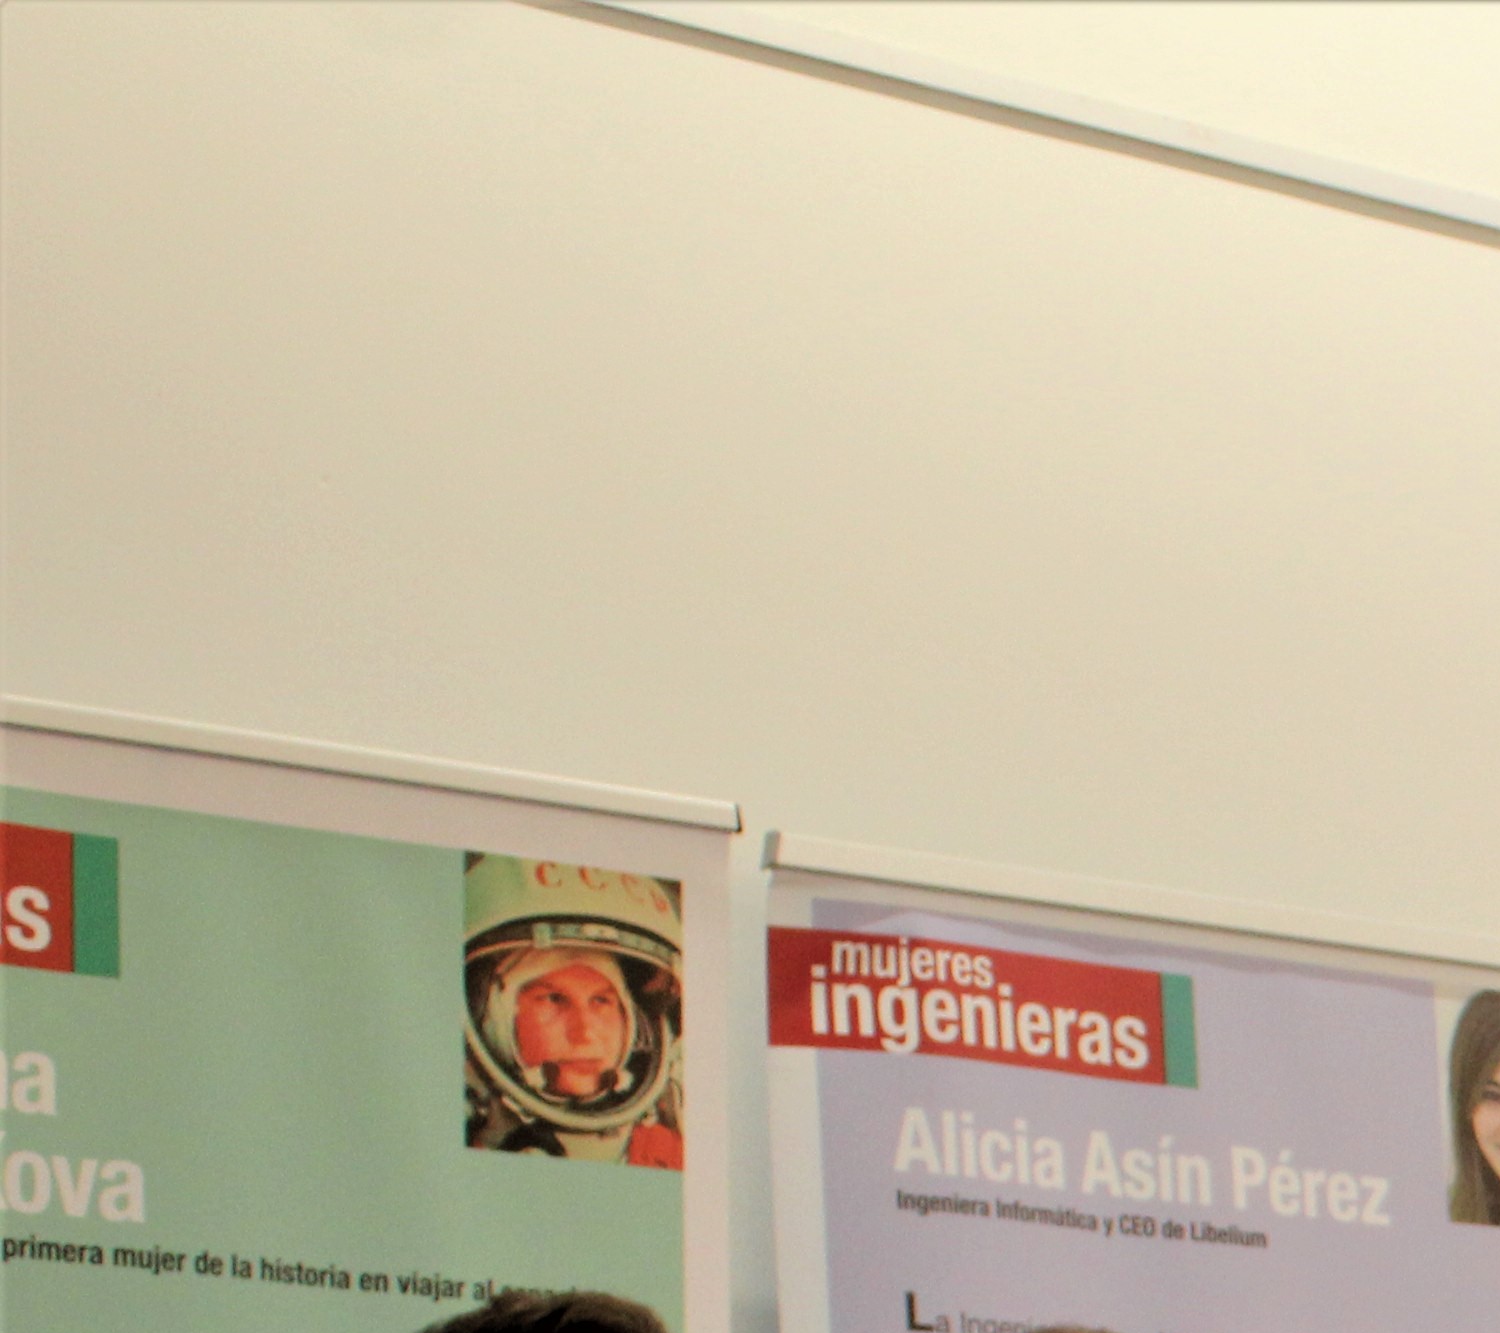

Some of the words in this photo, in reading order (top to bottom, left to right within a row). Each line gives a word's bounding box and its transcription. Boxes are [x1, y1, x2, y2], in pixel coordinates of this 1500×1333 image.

[832, 938, 994, 989] mujeres
[810, 964, 1150, 1071] ingenieras
[894, 1107, 1065, 1190] Alicia
[1082, 1131, 1212, 1205] Asín
[1231, 1146, 1391, 1226] Pérez
[896, 1189, 990, 1217] Ingeniera
[996, 1199, 1098, 1231] Informática
[1119, 1214, 1156, 1238] CEO
[1163, 1220, 1184, 1239] de
[2, 1236, 103, 1270] primera
[113, 1248, 186, 1275] mujer
[195, 1251, 222, 1276] de
[231, 1254, 252, 1279] la
[260, 1258, 351, 1290] historia
[359, 1272, 389, 1292] en
[398, 1271, 464, 1301] viajar
